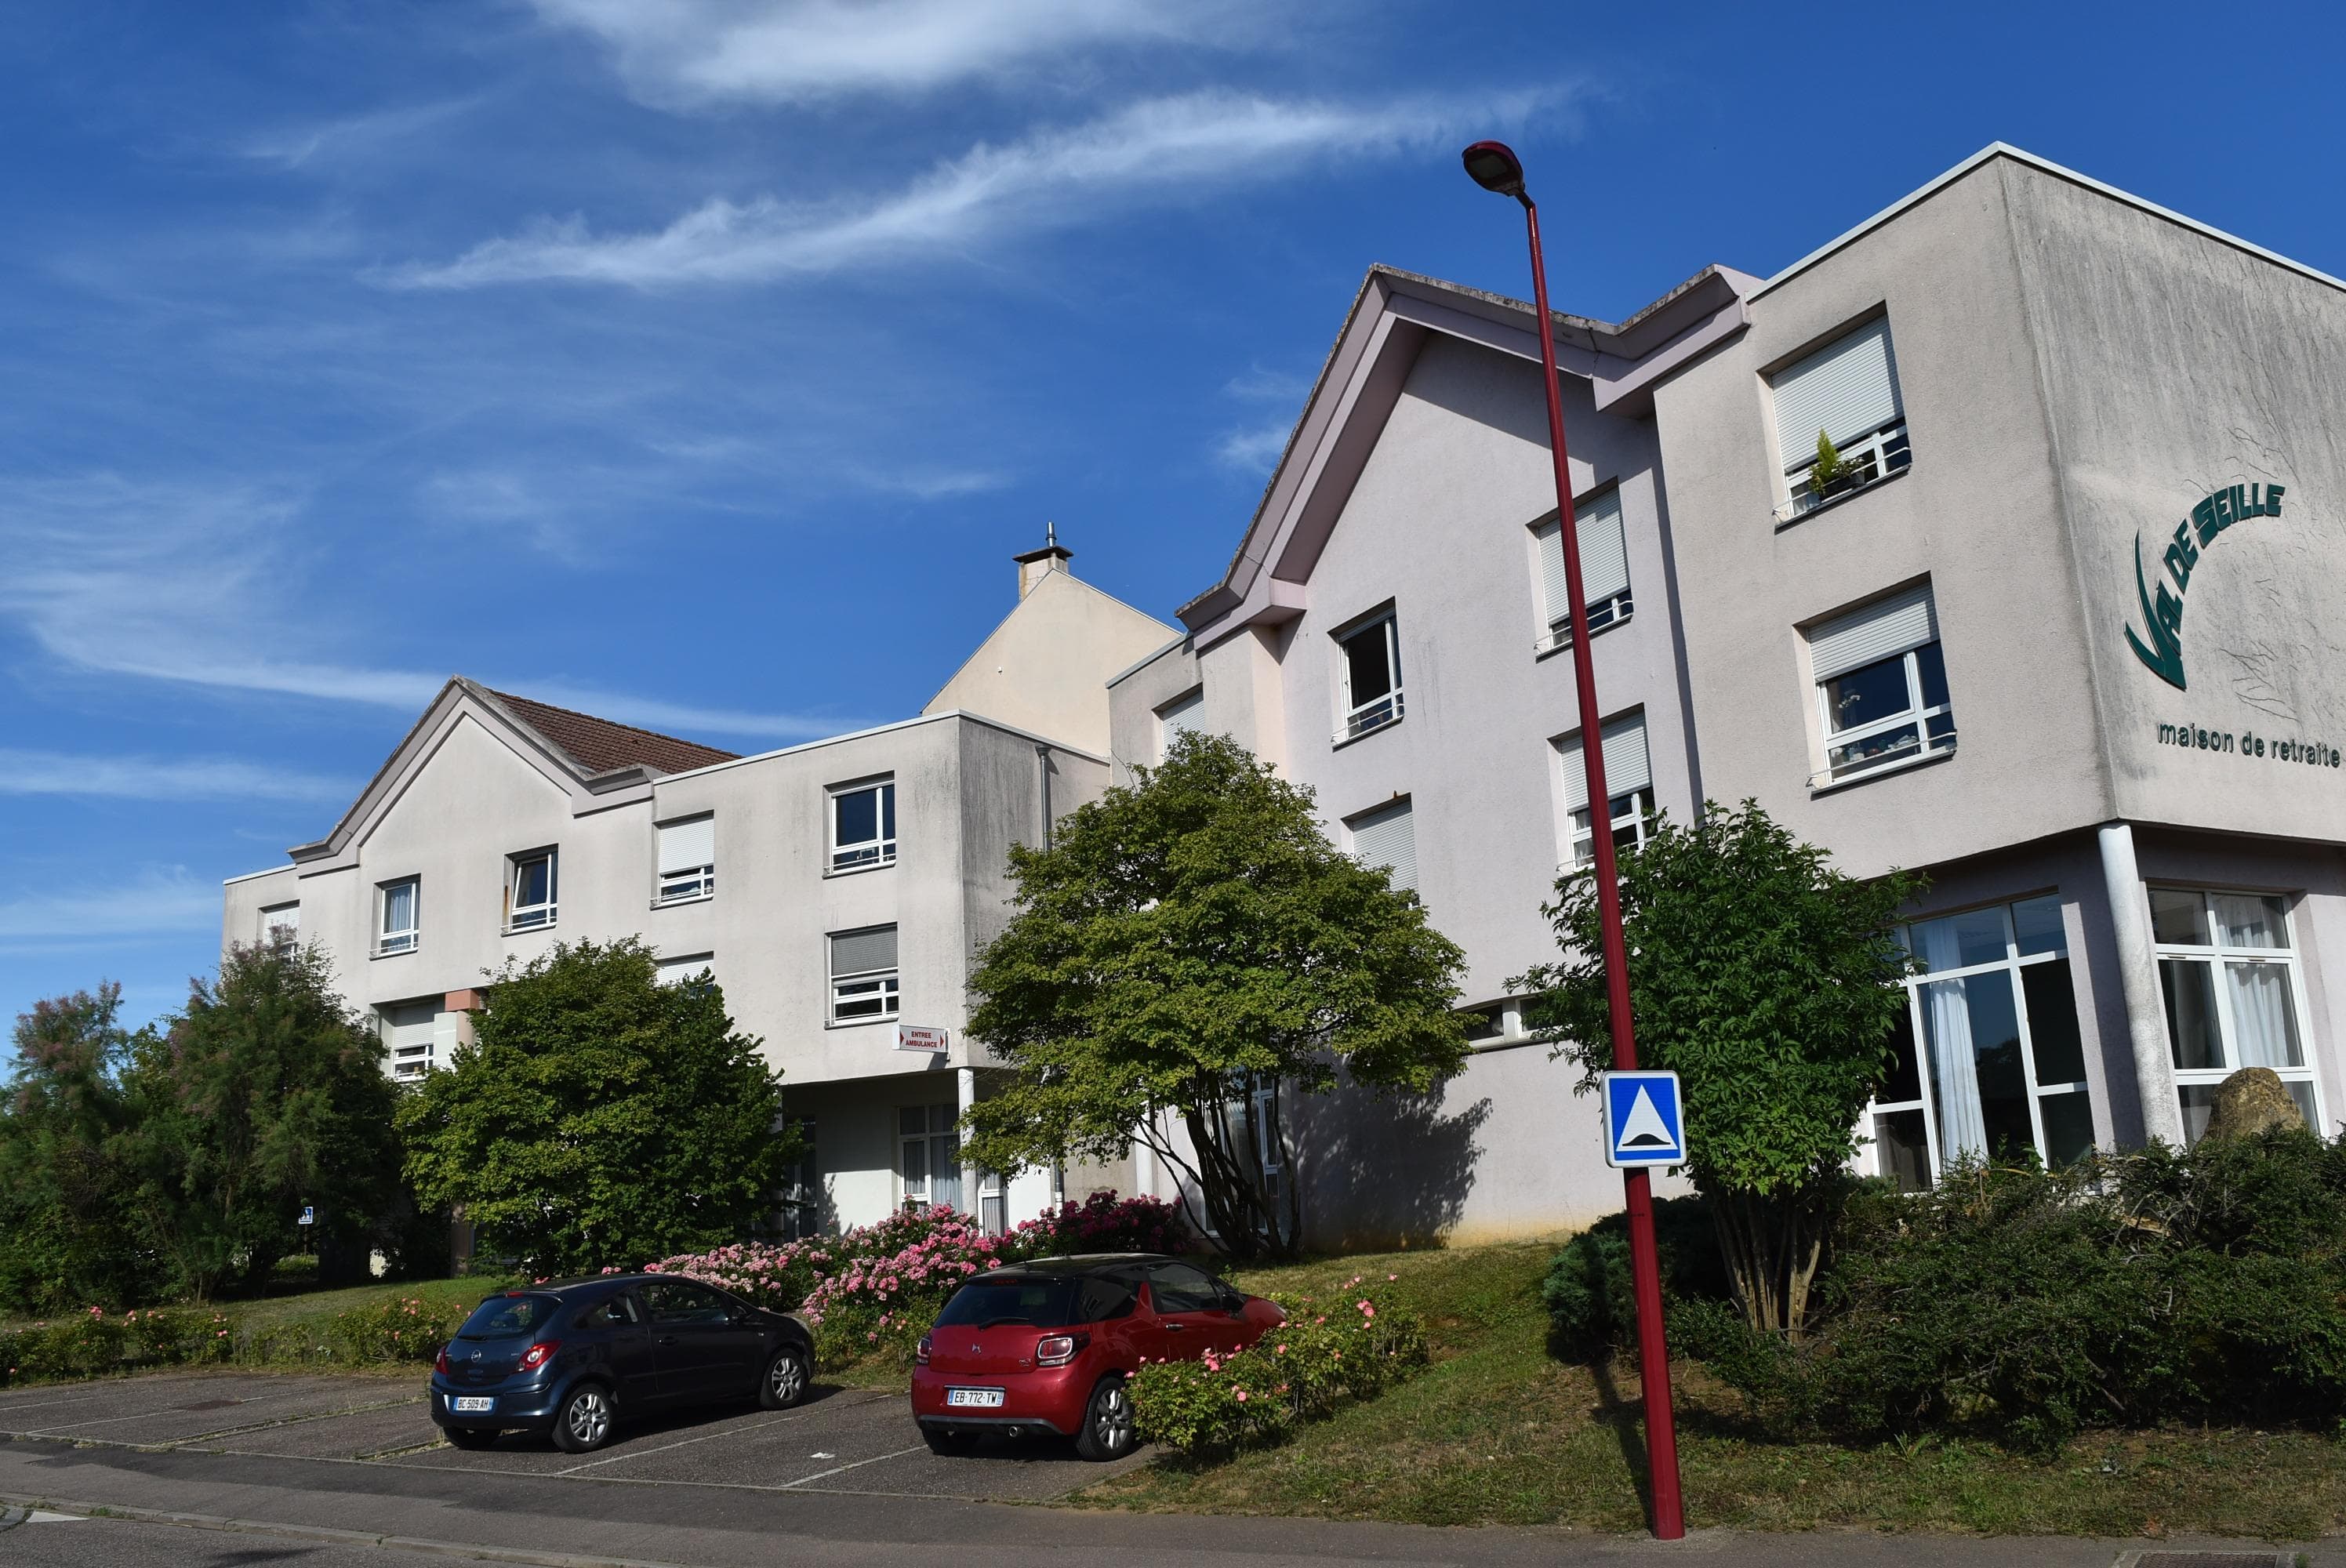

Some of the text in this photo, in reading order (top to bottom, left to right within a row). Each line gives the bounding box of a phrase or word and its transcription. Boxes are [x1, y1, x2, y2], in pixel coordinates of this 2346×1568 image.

[2123, 482, 2286, 691] VAL DE SEILLE
[2157, 721, 2341, 768] maison de retraite
